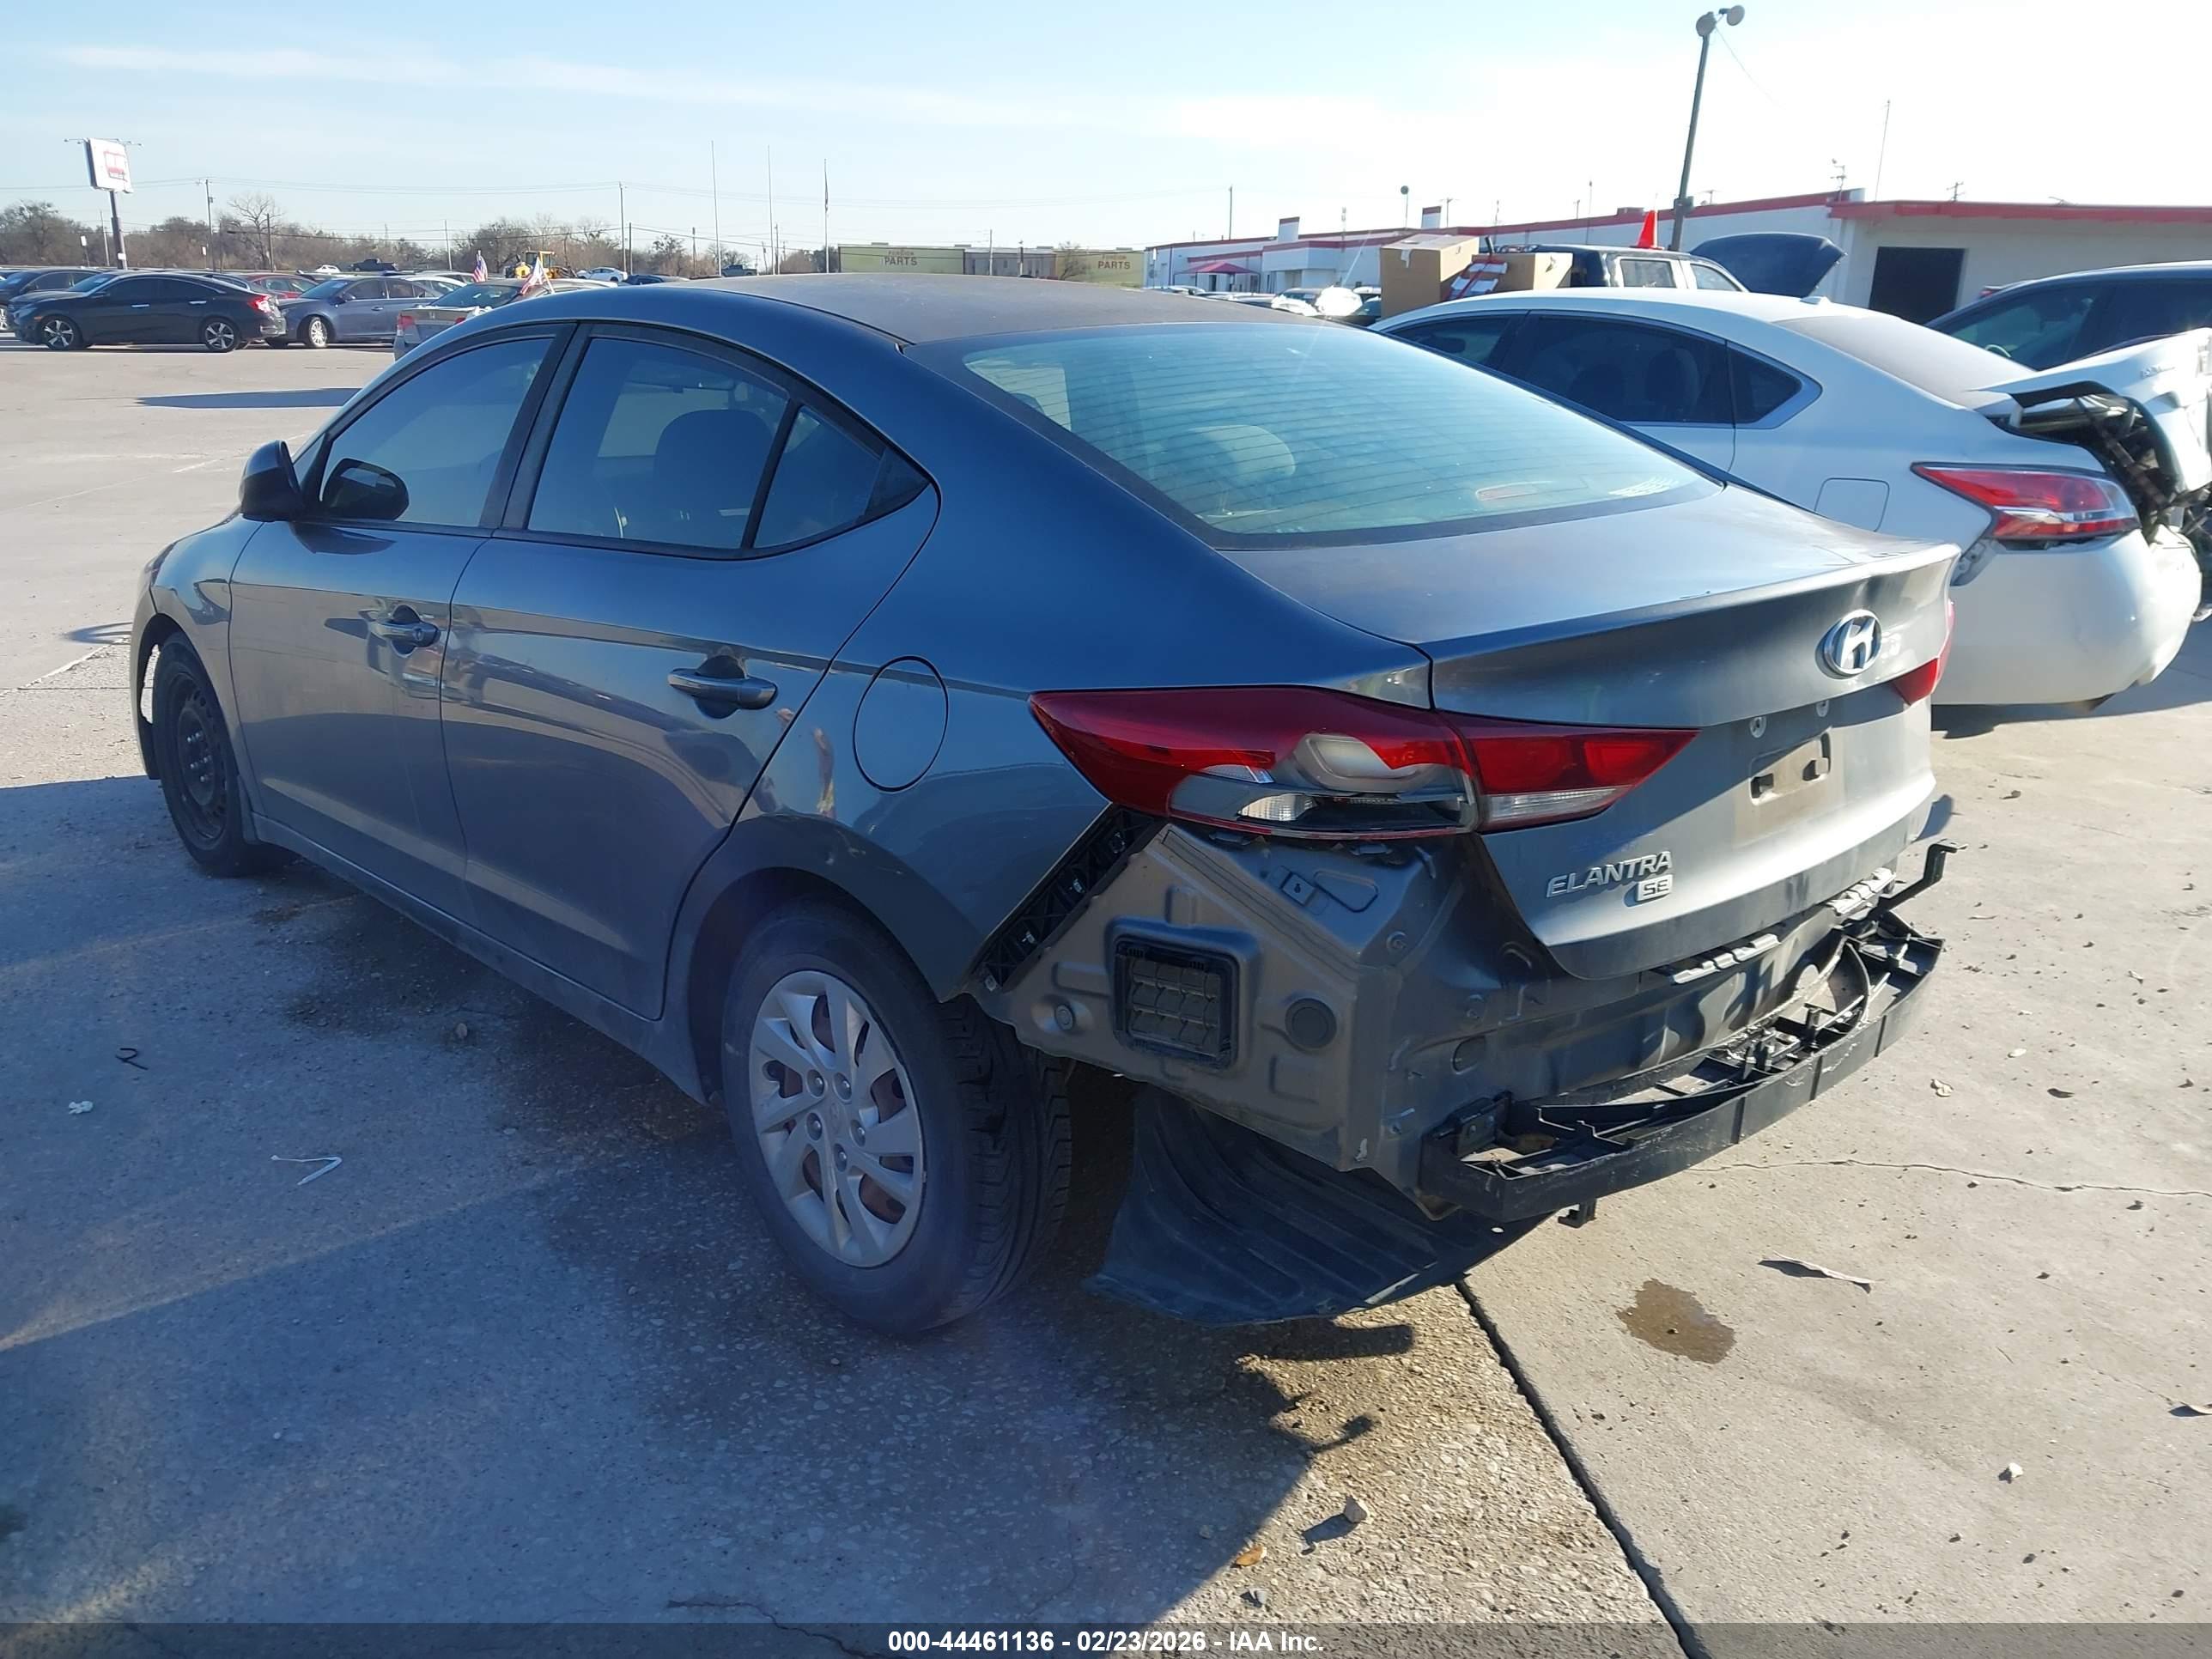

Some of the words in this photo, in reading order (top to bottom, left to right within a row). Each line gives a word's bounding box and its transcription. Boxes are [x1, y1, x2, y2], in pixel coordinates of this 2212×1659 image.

[884, 257, 917, 266] PARTS
[1098, 261, 1131, 270] PARTS
[1546, 851, 1673, 897] ELANTRA
